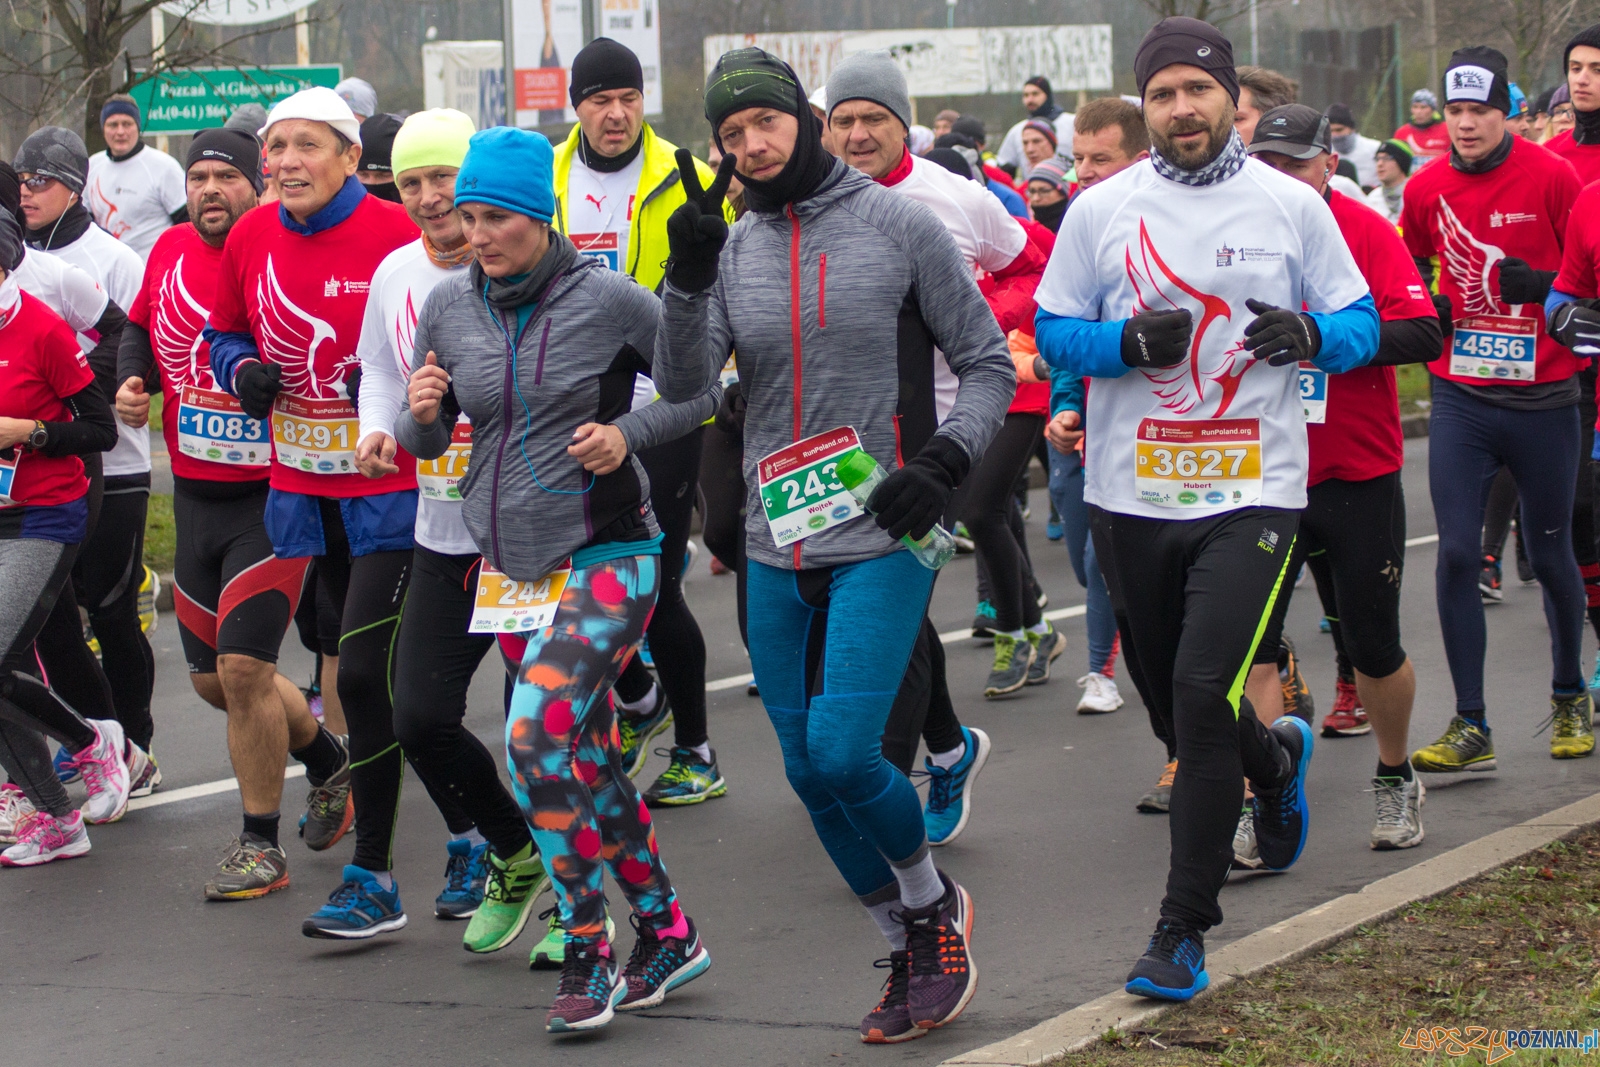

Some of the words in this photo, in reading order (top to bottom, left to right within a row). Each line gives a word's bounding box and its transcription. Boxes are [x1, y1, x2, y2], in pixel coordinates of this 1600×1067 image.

[1238, 248, 1246, 261] 1
[344, 280, 350, 294] 1
[1462, 334, 1526, 359] 4556
[181, 416, 188, 424] E
[192, 412, 262, 440] 1083
[283, 420, 348, 449] 8291
[1160, 427, 1166, 437] 1
[1201, 428, 1252, 436] RunPoland.org
[802, 436, 849, 458] RunPoland.org
[1140, 456, 1148, 464] D
[1152, 448, 1248, 477] 3627
[765, 498, 772, 508] C
[782, 462, 844, 510] 243
[808, 500, 834, 514] Wojtek
[1257, 541, 1274, 554] RUN
[480, 586, 488, 596] D
[498, 578, 552, 605] 244
